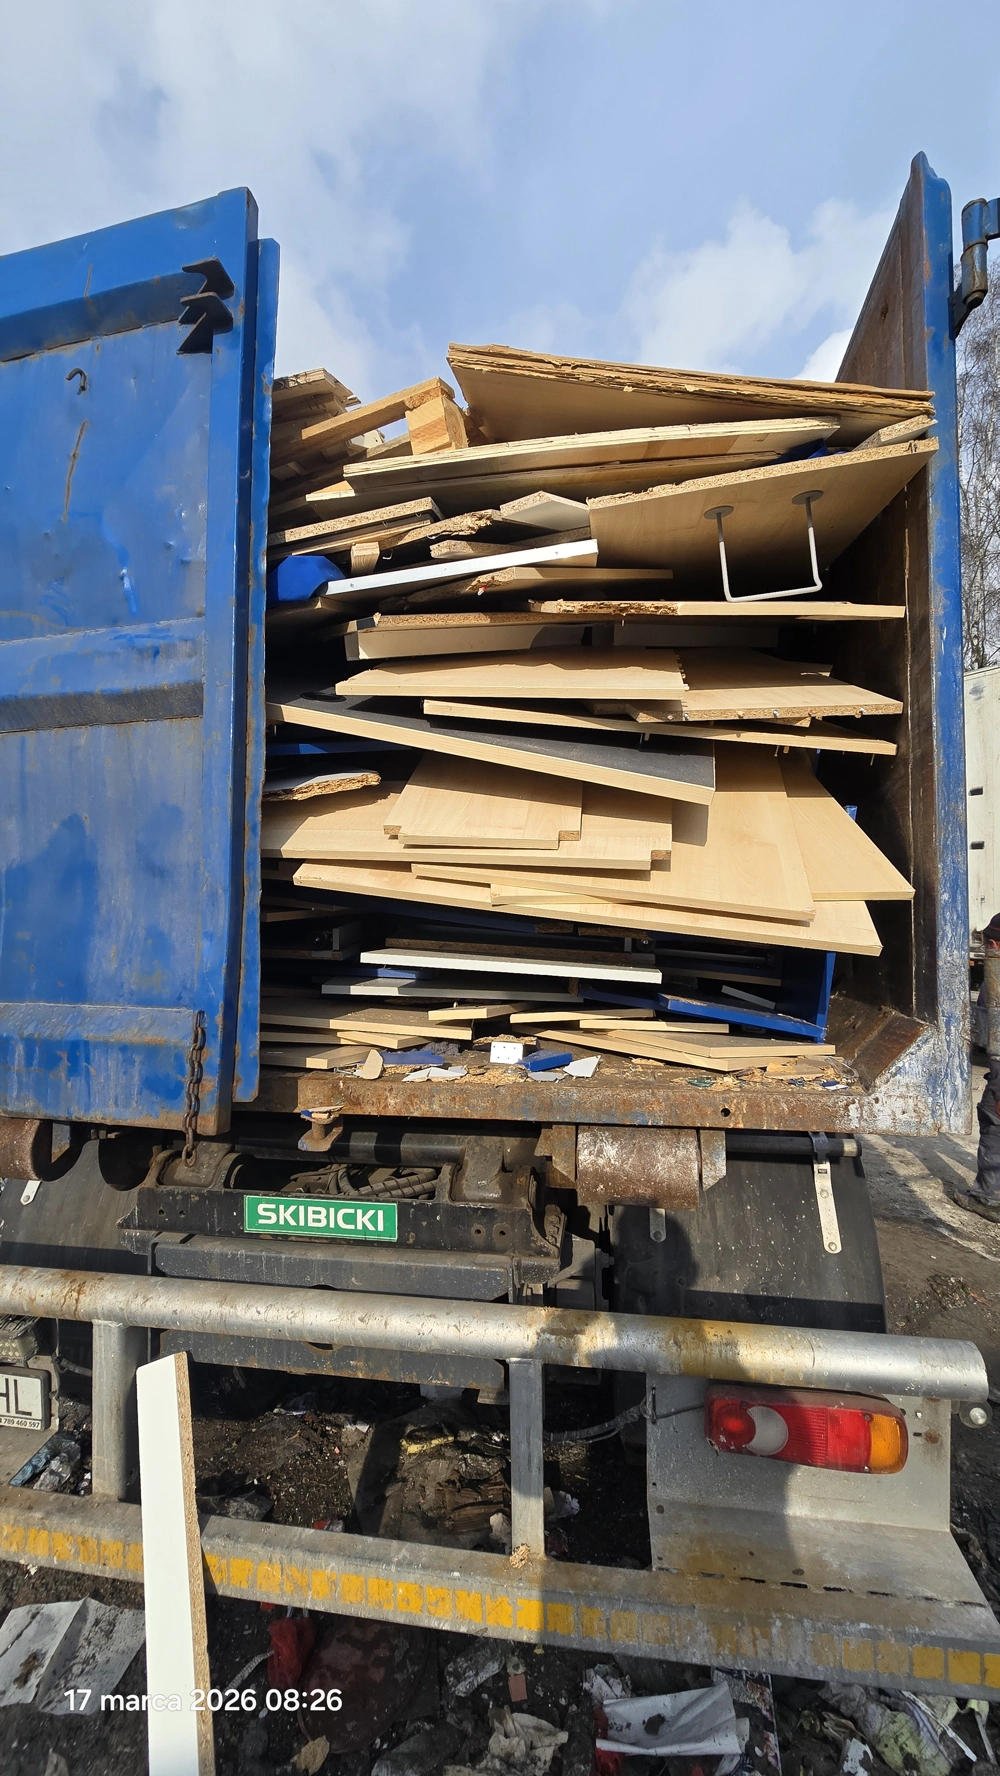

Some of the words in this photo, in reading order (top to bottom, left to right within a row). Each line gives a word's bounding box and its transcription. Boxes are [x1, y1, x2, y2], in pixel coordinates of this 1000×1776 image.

[256, 1203, 384, 1232] SKIBICKI
[3, 1418, 15, 1426] 789
[16, 1419, 28, 1427] 460
[28, 1421, 40, 1429] 597
